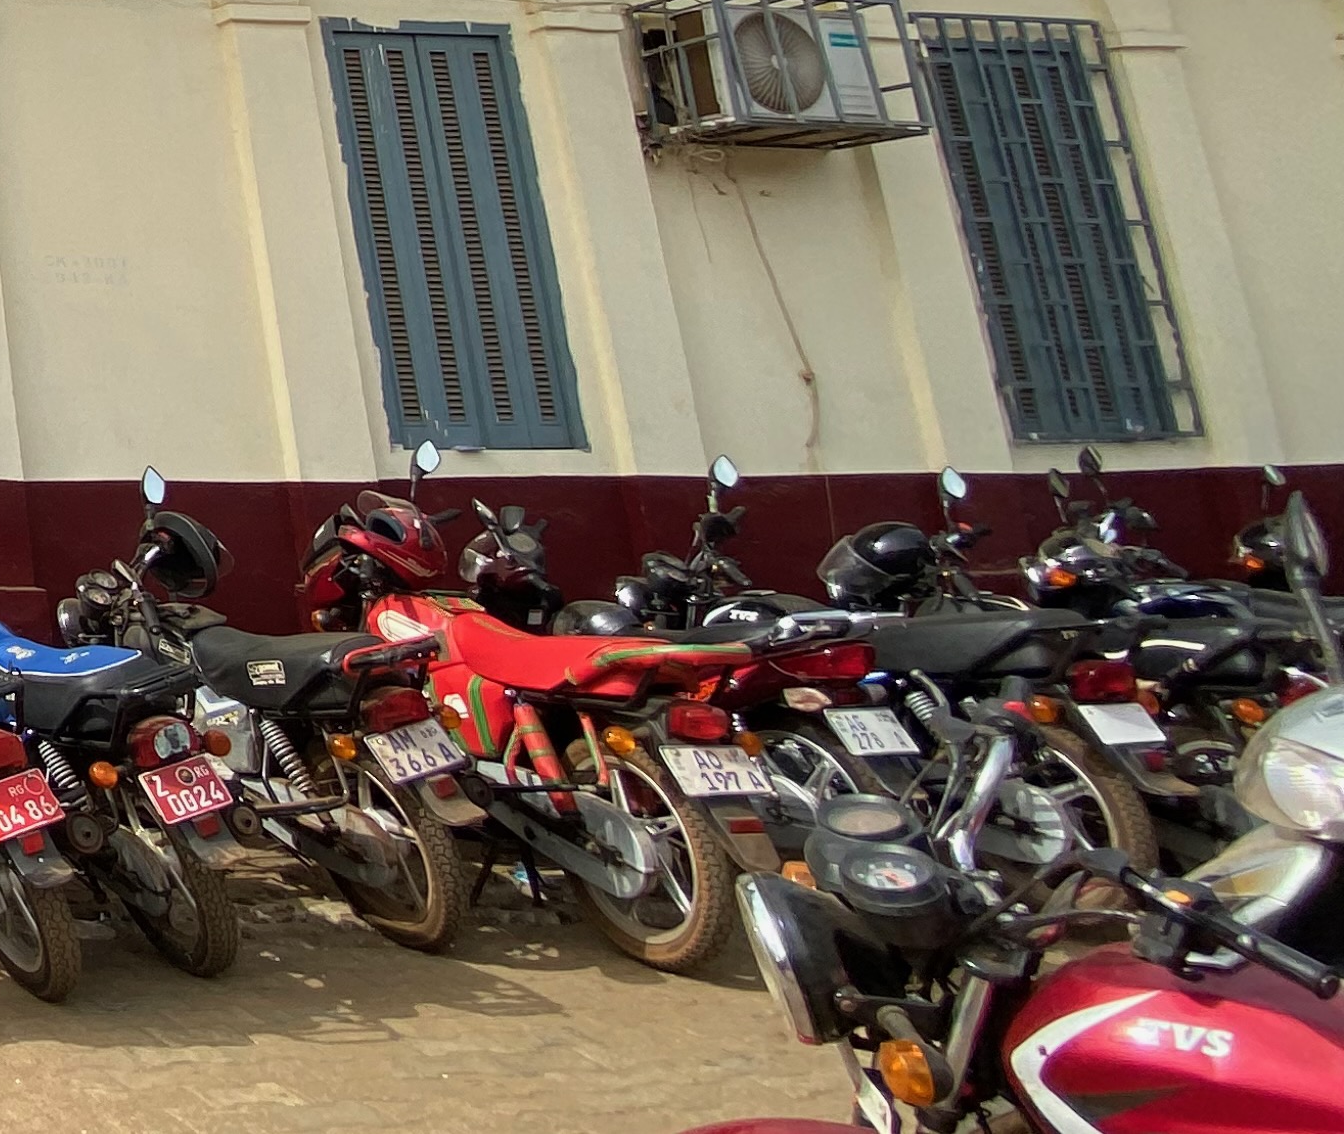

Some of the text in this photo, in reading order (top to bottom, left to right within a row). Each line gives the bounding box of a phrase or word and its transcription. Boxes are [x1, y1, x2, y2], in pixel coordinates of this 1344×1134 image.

[386, 728, 417, 754] AM
[389, 742, 457, 777] 366 A
[7, 784, 25, 797] RG
[151, 765, 209, 798] Z RG
[701, 770, 766, 791] 197 A
[167, 781, 224, 817] 0024
[1128, 1017, 1235, 1058] TVS
